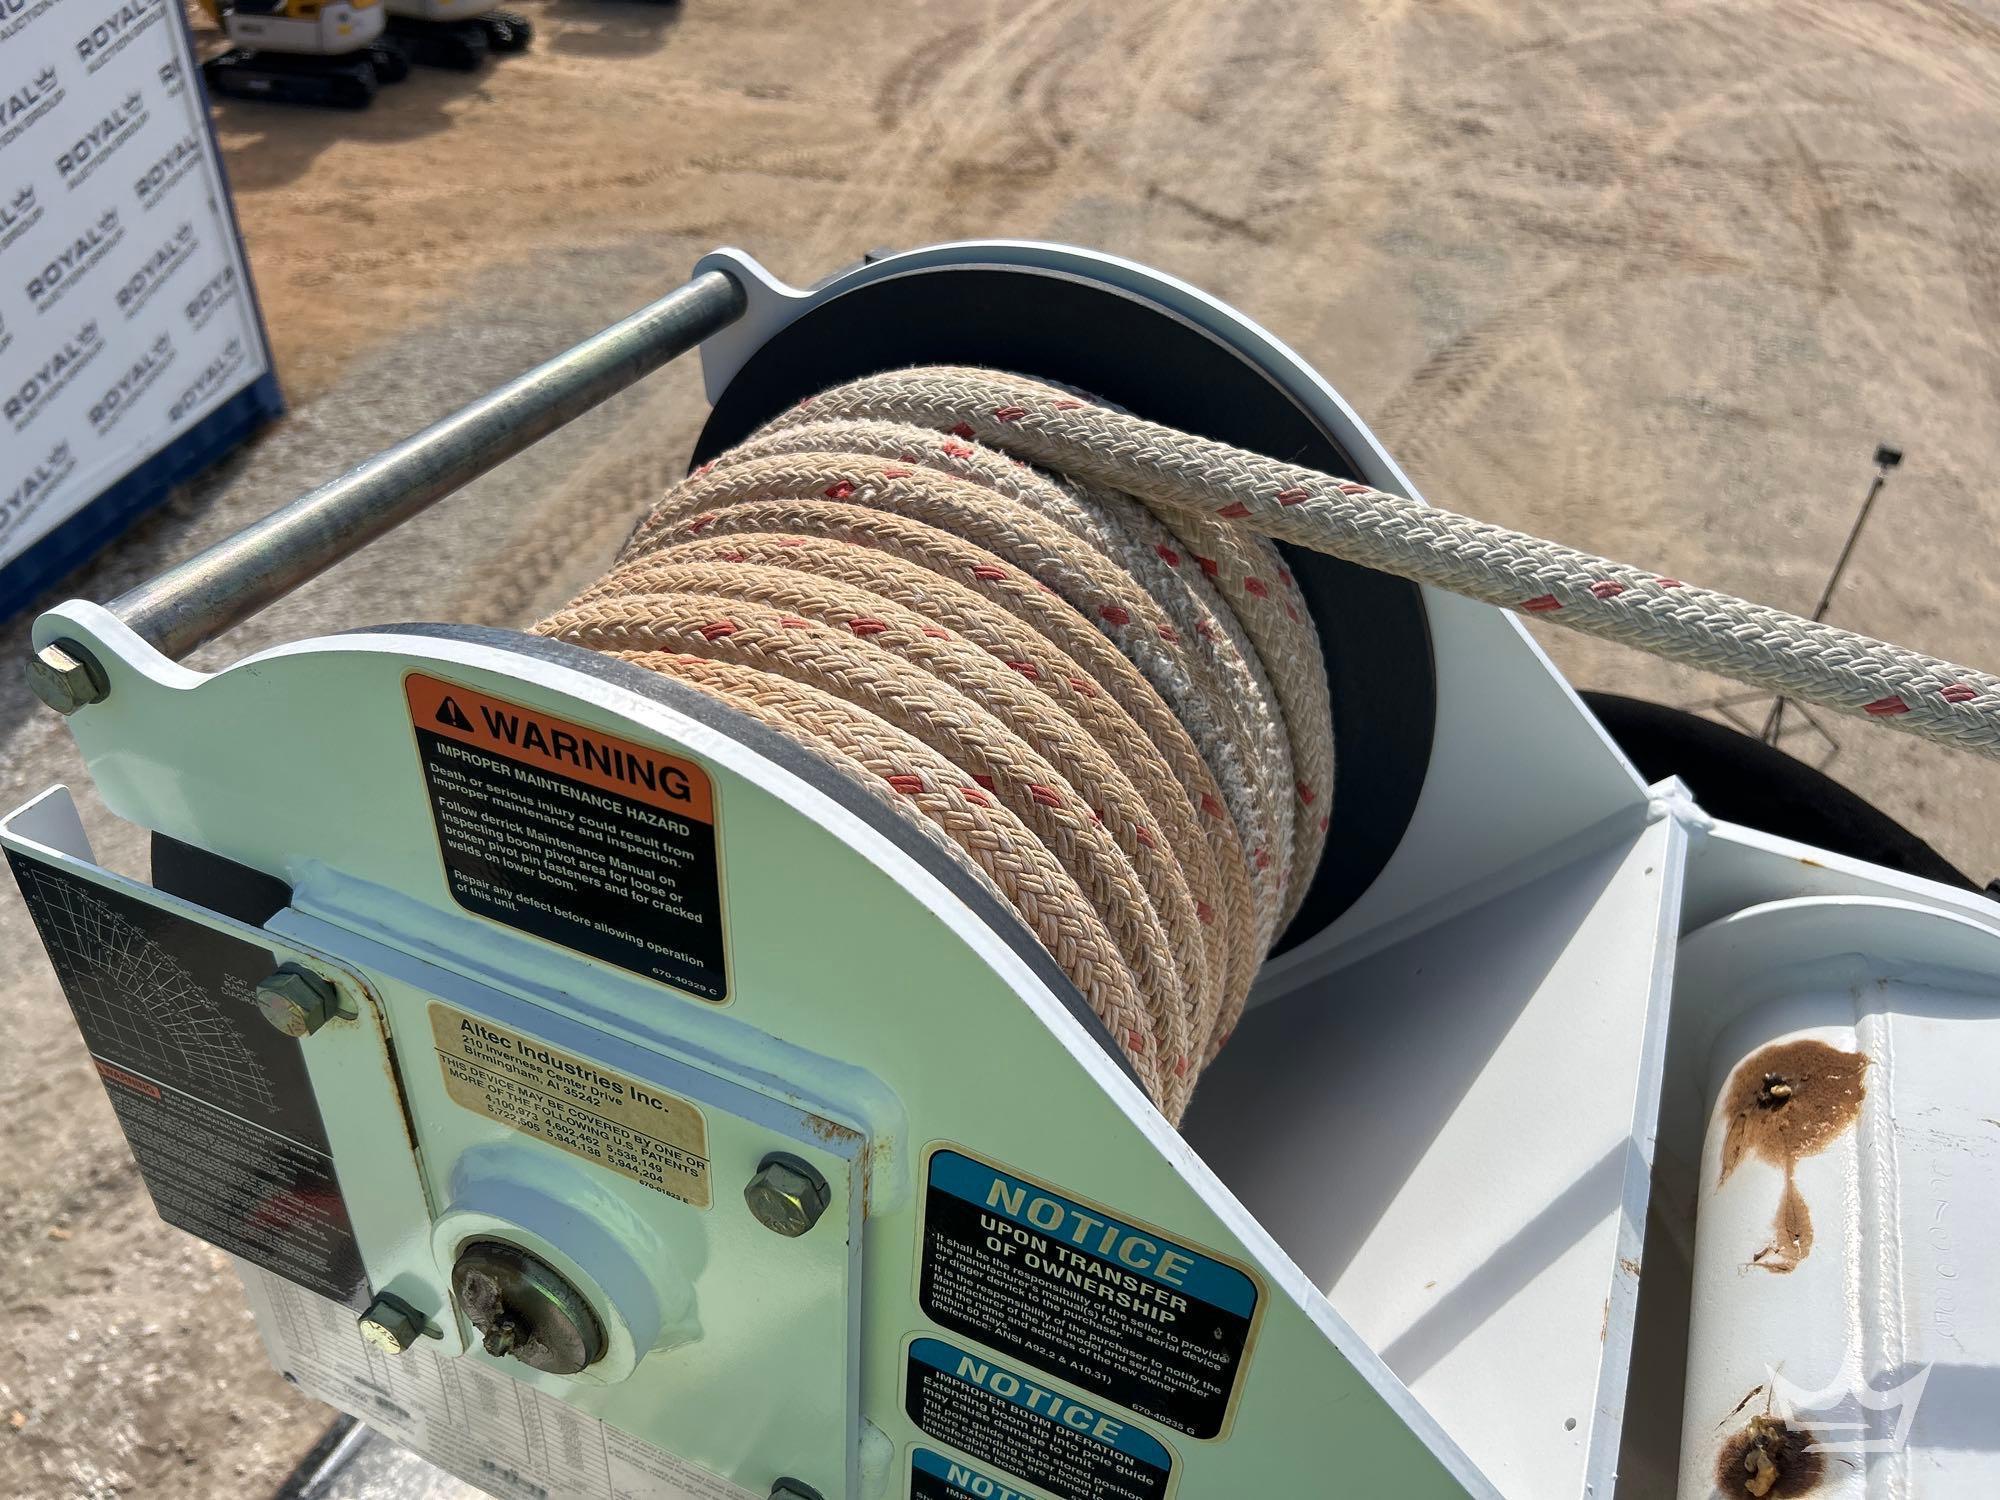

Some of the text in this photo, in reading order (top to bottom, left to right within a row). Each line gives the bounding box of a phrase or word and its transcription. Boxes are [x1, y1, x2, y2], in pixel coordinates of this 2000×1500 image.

[76, 0, 147, 59] ROYAL
[56, 109, 128, 176] ROYAL
[26, 228, 103, 300] ROYAL
[115, 240, 177, 307] ROYAL
[4, 343, 80, 419] ROYAL
[87, 353, 157, 425] ROYAL
[436, 742, 690, 836] IMPROPER MAINTENANCE HAZARD
[479, 705, 691, 802] WARNING
[429, 762, 694, 860] Death or serious injury could result from
[438, 795, 676, 887] Follow derrick Maintenance Manual on
[492, 797, 575, 831] maintenance
[578, 827, 603, 841] and
[607, 834, 681, 868] inspection.
[441, 809, 683, 903] inspecting boom pivot area for loose or
[444, 823, 702, 923] broken pivot pin fasteners and for cracked
[447, 838, 577, 891] welds on lower boom.
[456, 883, 519, 912] of this unit.
[453, 869, 704, 968] Repair any defect before allowing operation
[460, 1018, 669, 1113] Altec Industries Inc.
[461, 1034, 622, 1106] 210 Inverness Center Drive
[463, 1044, 543, 1085] Birmingham,
[563, 1085, 601, 1108] 35242
[439, 1053, 705, 1170] THIS DEVICE MAY BE COVERED BY ONE OR
[449, 1067, 699, 1177] MORE OF THE FOLLOWING U.S. PATENTS
[544, 1118, 600, 1147] 4,602,462
[606, 1143, 662, 1173] 5,538,149
[546, 1128, 601, 1157] 5,944,138
[607, 1154, 663, 1184] 5,944,204
[980, 1214, 1187, 1313] UPON TRANSFER
[985, 1178, 1194, 1285] NOTICE
[932, 1291, 1010, 1330] within 60 days.
[935, 1253, 1123, 1339] or digger derrick to the purchaser.
[936, 1232, 1227, 1363] It shall be the responsibility of the seller to provide
[936, 1242, 1221, 1371] the manufacturer's manual(s) for this aerial device
[986, 1236, 1175, 1323] OF OWNERSHIP
[994, 1327, 1022, 1344] ANSI
[1024, 1341, 1055, 1359] A92.2
[1058, 1355, 1066, 1364] &
[1069, 1361, 1111, 1384] A10.31)
[922, 1386, 1095, 1470] may cause damage to unit.
[923, 1375, 1154, 1485] Extending boom tip into pole guide
[935, 1371, 1134, 1466] IMPROPER BOOM OPERATION
[956, 1356, 1123, 1444] NOTICE
[1132, 1403, 1195, 1435] 670-40235 G
